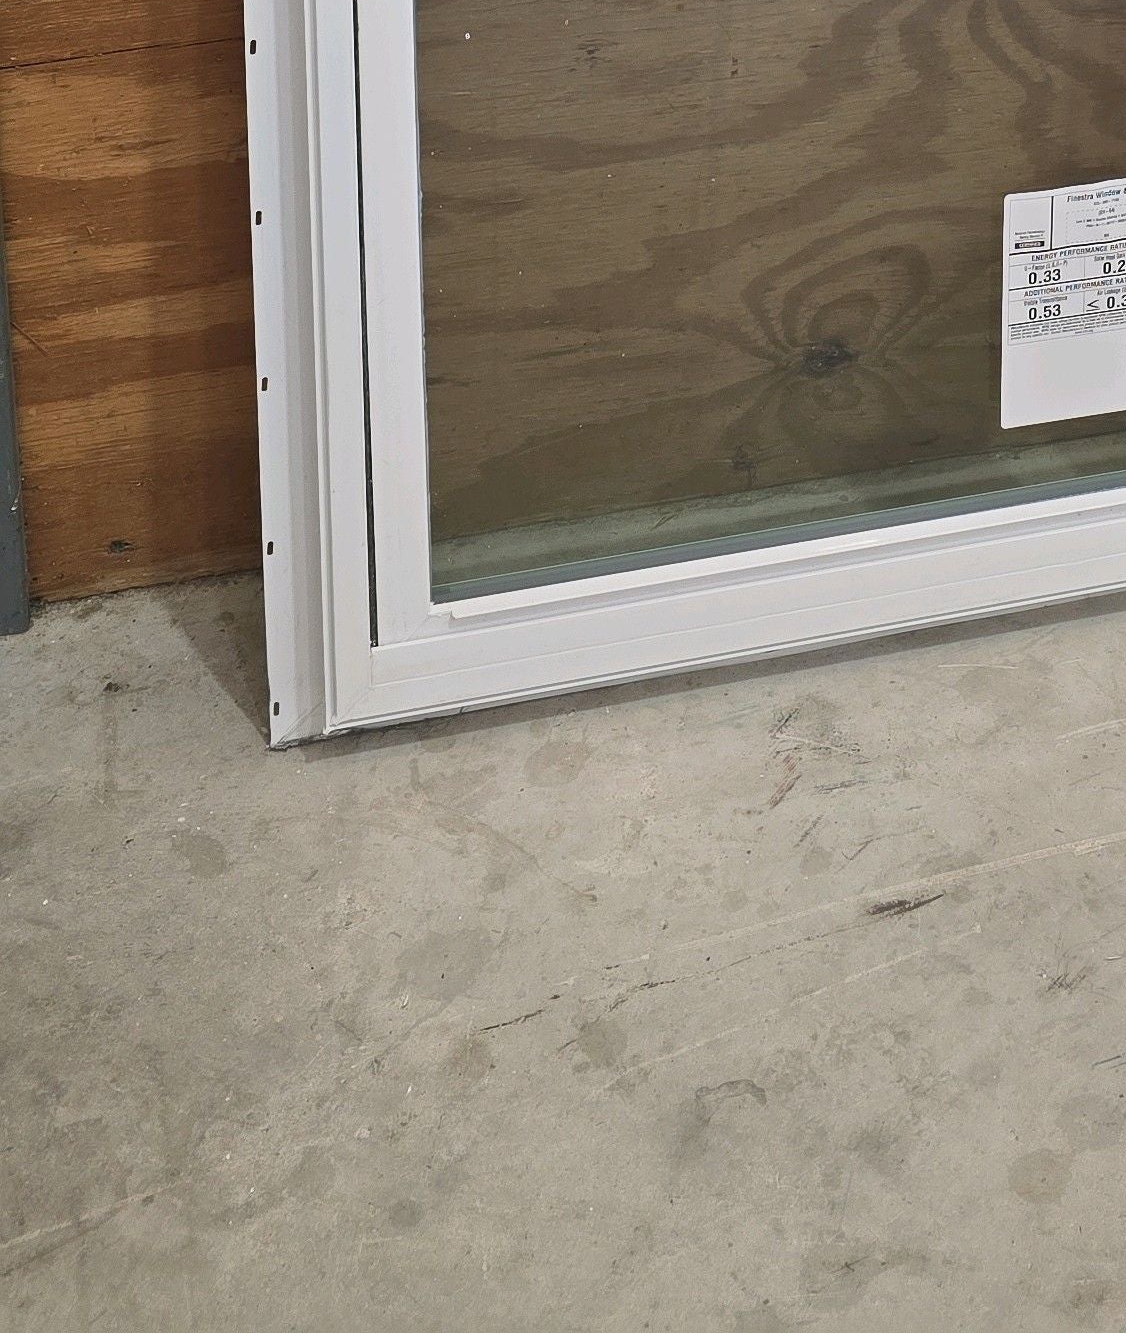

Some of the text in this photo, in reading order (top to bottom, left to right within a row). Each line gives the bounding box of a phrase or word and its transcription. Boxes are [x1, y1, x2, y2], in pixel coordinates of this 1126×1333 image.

[1067, 194, 1094, 203] Finestra
[1095, 189, 1121, 199] Window
[1031, 251, 1058, 262] ENERGY
[1059, 245, 1109, 257] PERFORMANCE
[1028, 268, 1061, 285] 0.33
[1024, 286, 1064, 298] ADDITIONAL
[1065, 279, 1113, 291] PERFORMANCE
[1028, 304, 1061, 321] 0.53
